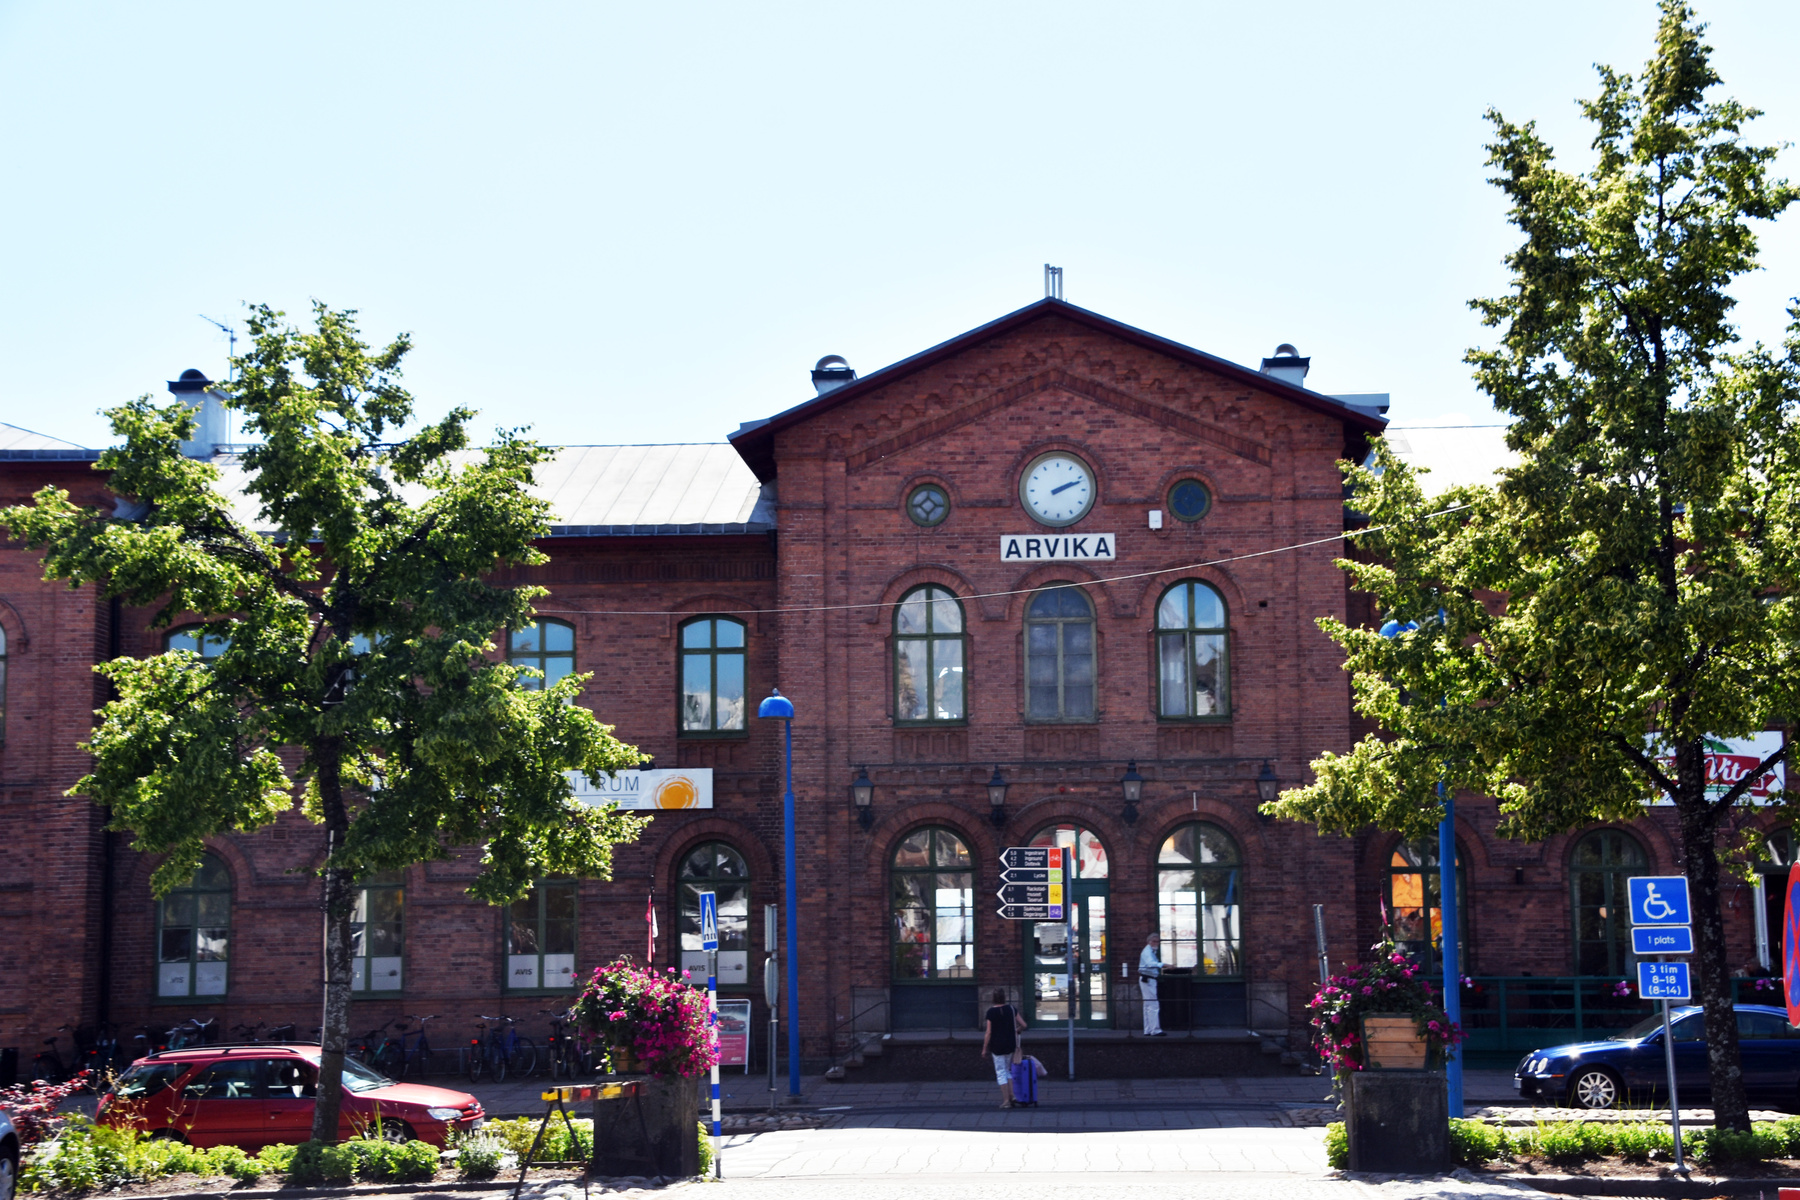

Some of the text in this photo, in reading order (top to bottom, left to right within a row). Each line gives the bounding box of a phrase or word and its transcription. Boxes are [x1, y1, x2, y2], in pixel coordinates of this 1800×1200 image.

[1005, 537, 1111, 558] ARVIKA
[1647, 935, 1676, 946] 1 plats
[515, 968, 533, 976] AVIS
[688, 964, 706, 972] AVIS
[1649, 964, 1678, 974] 3 tim
[1652, 975, 1676, 984] 8-18
[1648, 985, 1682, 996] (8-14)
